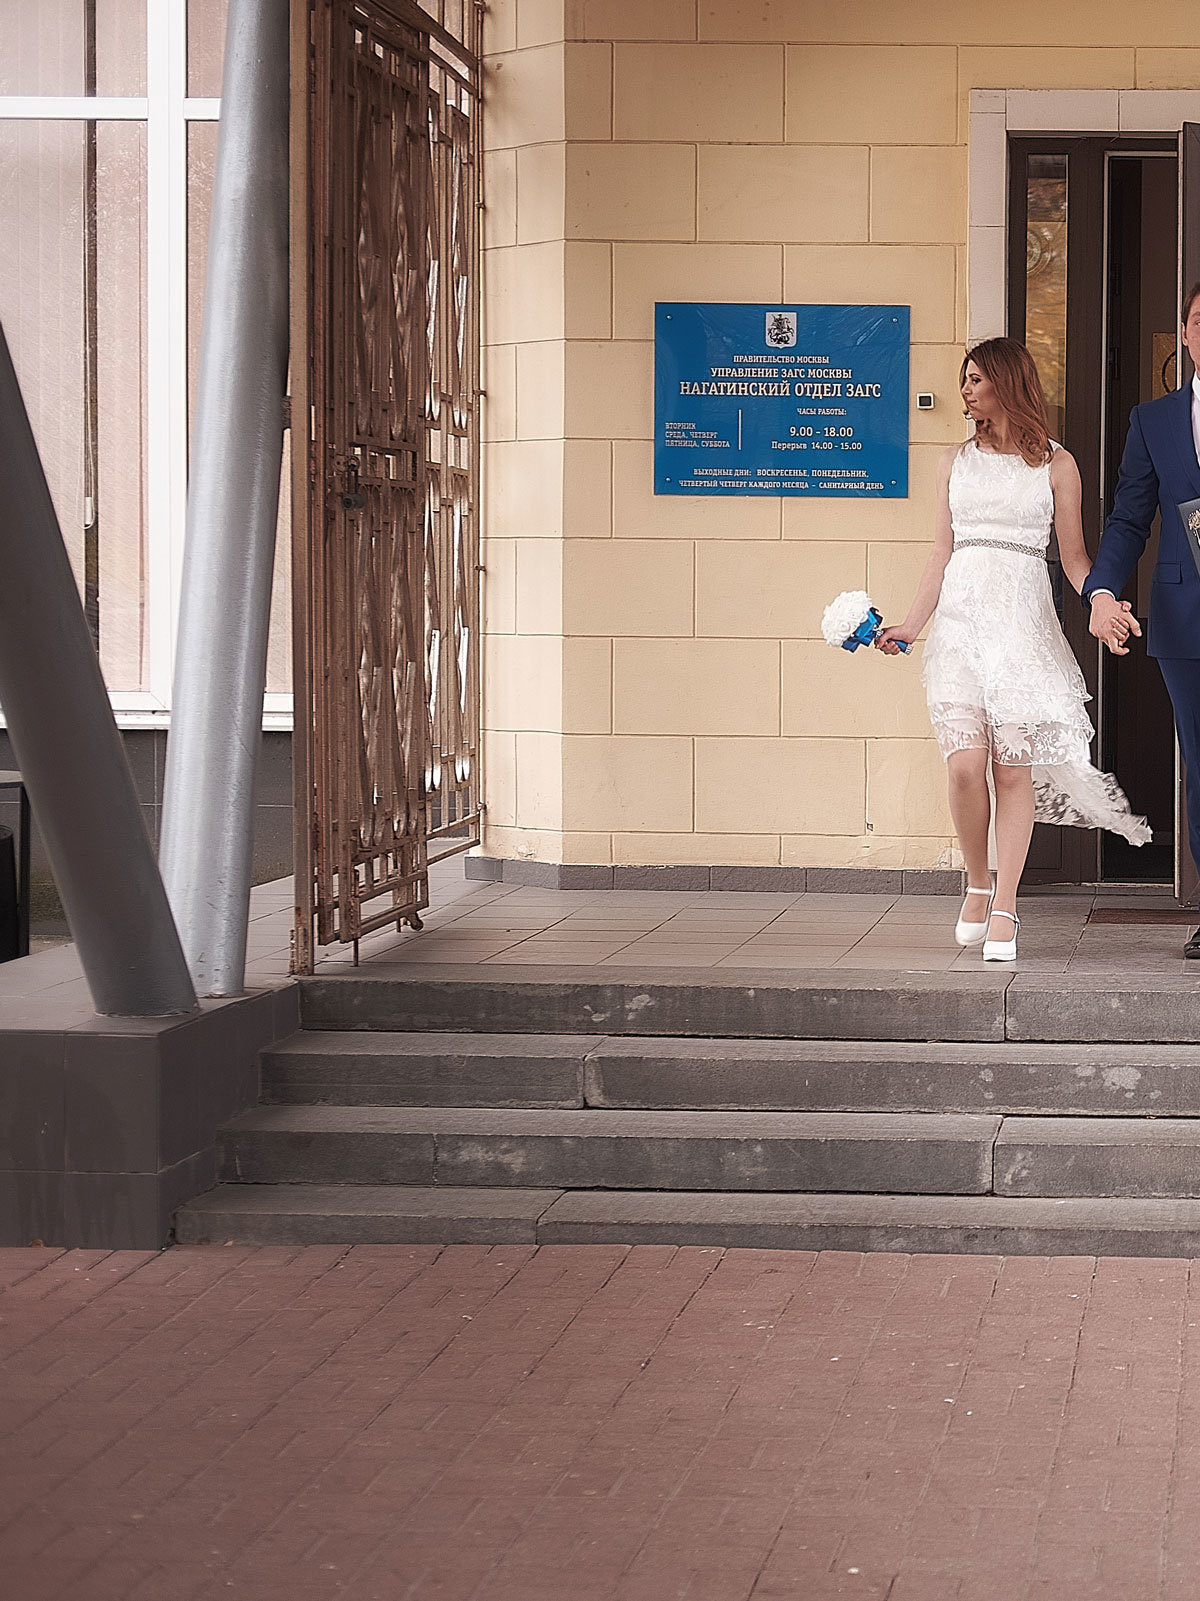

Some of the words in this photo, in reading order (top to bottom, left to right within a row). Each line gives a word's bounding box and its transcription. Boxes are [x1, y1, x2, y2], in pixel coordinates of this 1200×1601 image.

[733, 355, 795, 364] ПРАВИТЕЛЬСТВО
[797, 356, 830, 364] МОСКВЫ
[711, 367, 779, 378] УПРАВЛЕНИЕ
[781, 368, 805, 379] ЗАГС
[808, 369, 852, 379] МОСКВЫ
[680, 380, 790, 396] НАГАТИНСКИЙ
[795, 382, 842, 399] ОТДЕЛ
[846, 384, 881, 397] ЗАГС
[665, 422, 696, 430] ВТОРНИК
[665, 431, 688, 439] СРЕДА,
[690, 431, 718, 439] ЧЕТВЕРГ
[790, 426, 813, 437] 9.00
[824, 427, 853, 437] 18.00
[665, 440, 700, 448] ПЯТНИЦА,
[701, 440, 730, 448] СУББОТА
[771, 441, 807, 451] Перерыв
[811, 441, 833, 450] 14.00
[840, 442, 862, 450] 15.00
[693, 468, 733, 476] ВЫХОДНЫЕ
[734, 469, 752, 477] ДНИ:
[757, 469, 809, 478] ВОСКРЕСЕНЬЕ,
[811, 469, 869, 478] ПОНЕДЕЛЬНИК,
[679, 480, 717, 488] ЧЕТВЕРТЫЙ
[719, 480, 747, 488] ЧЕТВЕРГ
[748, 481, 780, 489] КАЖДОГО
[782, 482, 809, 490] МЕСЯЦА
[819, 481, 865, 490] САНИТАРНЫЙ
[866, 482, 884, 490] ДЕНЬ
